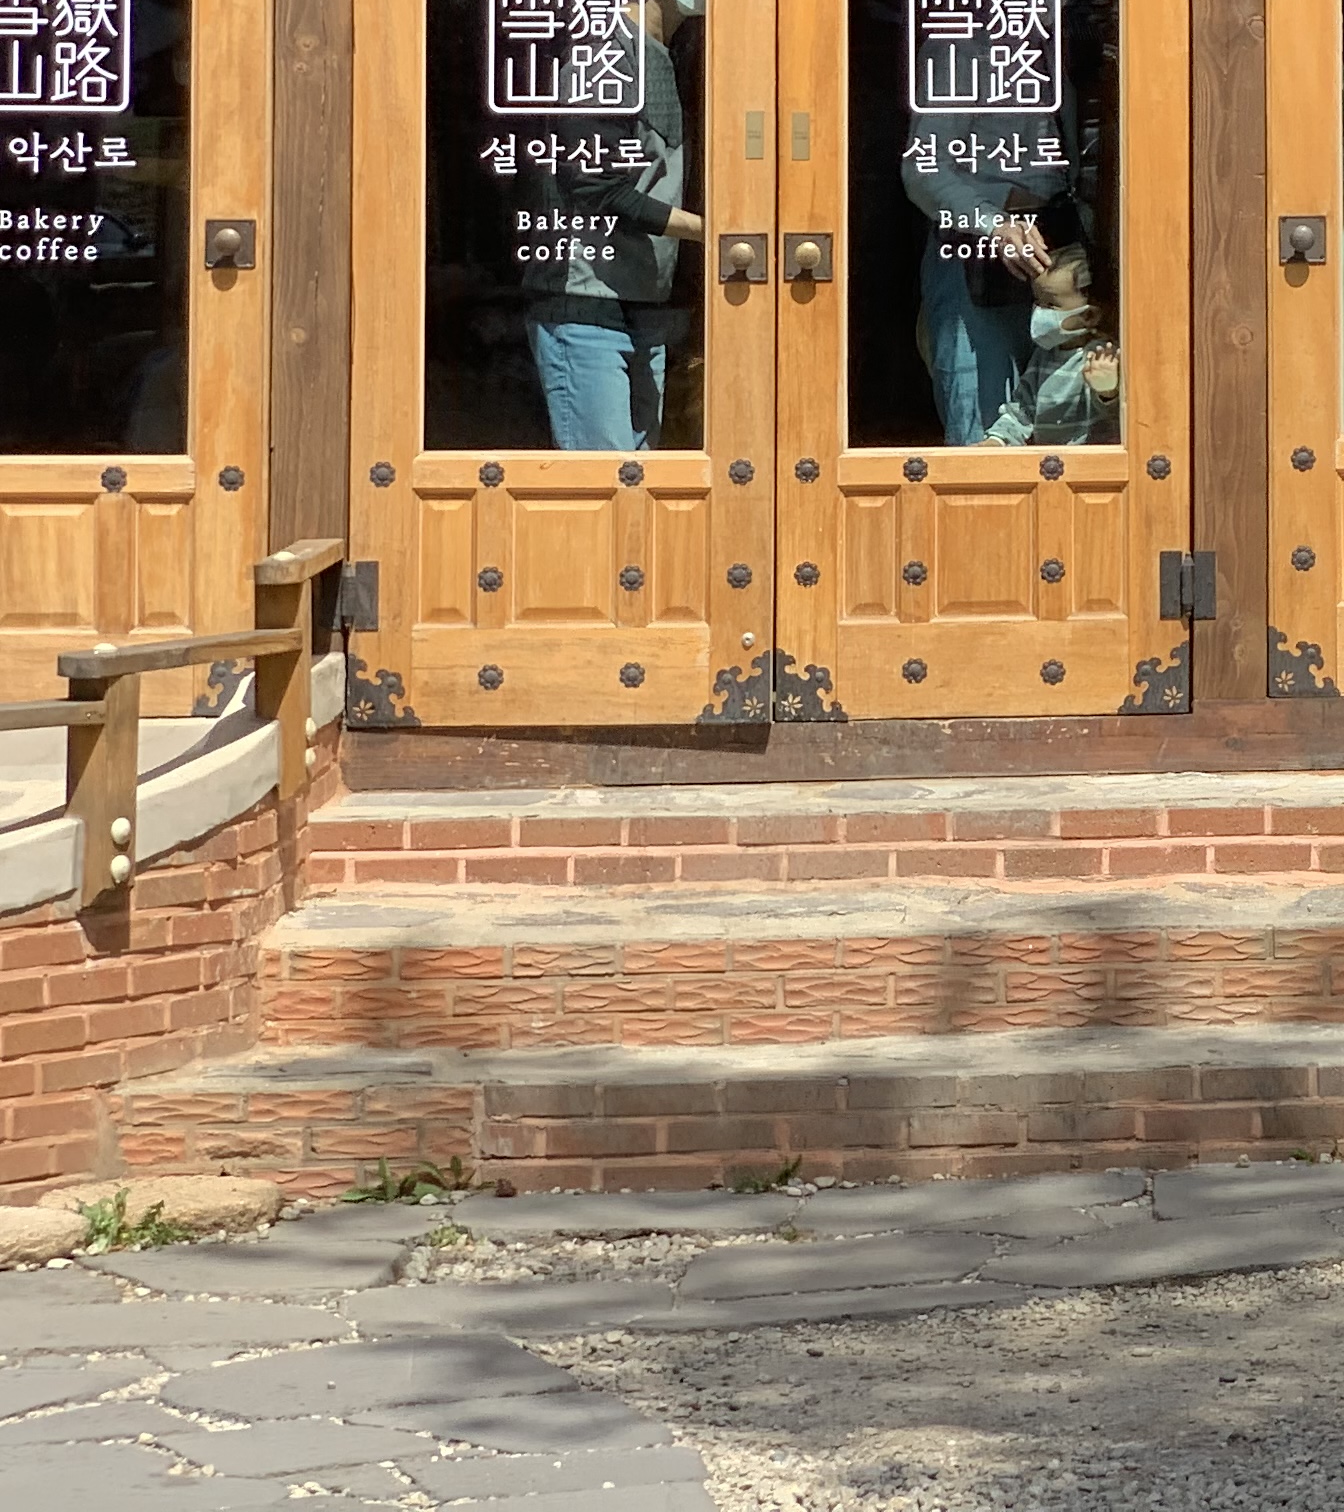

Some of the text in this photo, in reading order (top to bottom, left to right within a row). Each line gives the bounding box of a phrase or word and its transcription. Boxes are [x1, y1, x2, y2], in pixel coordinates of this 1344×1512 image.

[480, 133, 653, 175] 설악산로
[902, 132, 1071, 174] 설악산로
[0, 207, 105, 236] Bakery
[517, 208, 619, 237] Bakery
[938, 208, 1039, 234] Bakery
[0, 237, 98, 261] coffee
[517, 239, 616, 261] coffee
[939, 236, 1036, 259] coffee
